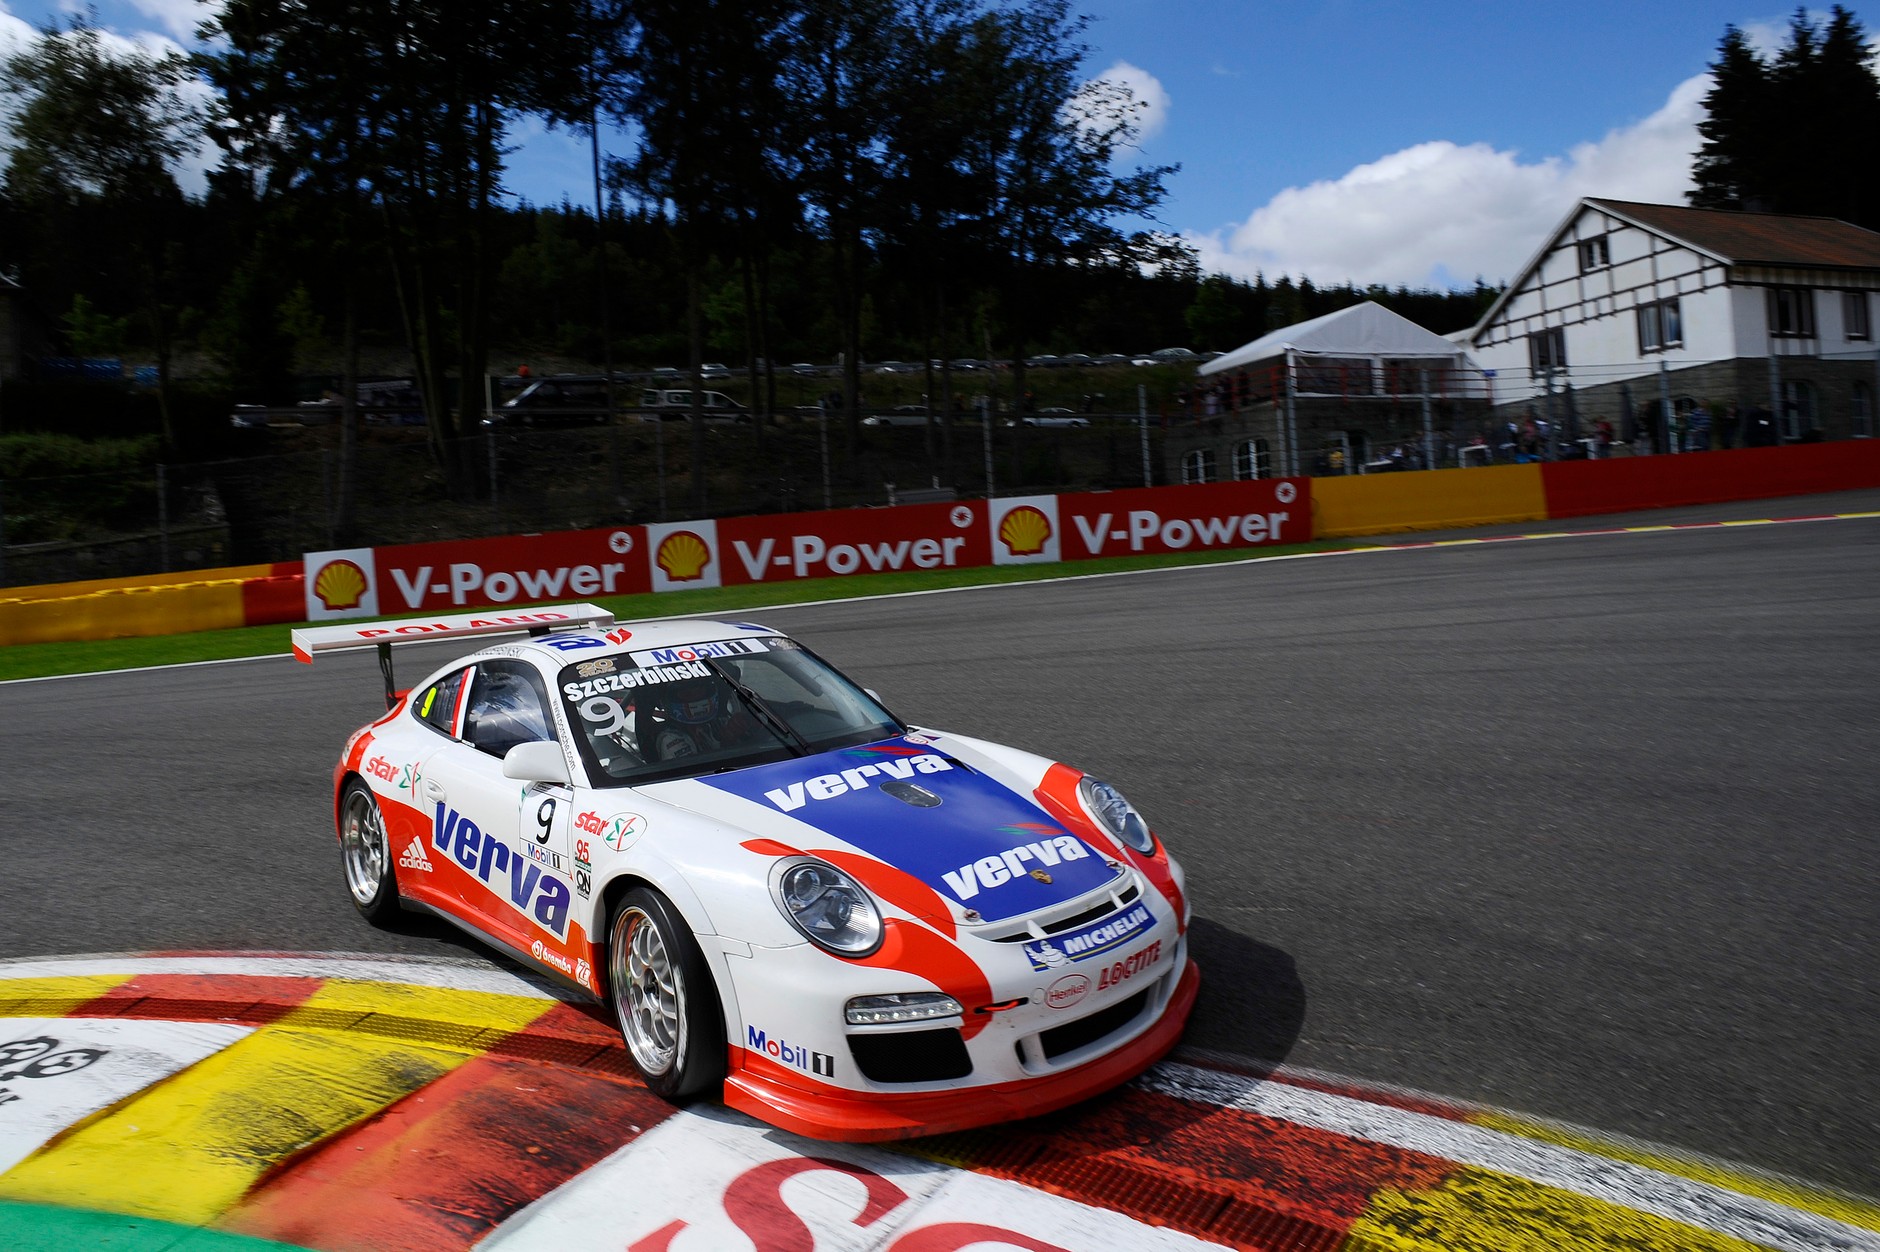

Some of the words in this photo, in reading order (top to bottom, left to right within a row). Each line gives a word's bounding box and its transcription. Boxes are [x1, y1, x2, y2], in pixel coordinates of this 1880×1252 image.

[1072, 510, 1289, 554] V-Power
[733, 535, 965, 580] V-Power
[391, 562, 625, 608] V-Power
[357, 613, 569, 638] POLAND
[651, 643, 727, 663] Mobil
[726, 641, 750, 654] 1
[563, 660, 712, 702] Szczerbinski
[580, 696, 626, 737] 9
[366, 756, 400, 782] star
[764, 753, 953, 813] verva
[536, 797, 557, 844] 9
[574, 811, 609, 836] star
[399, 856, 433, 873] adidas
[435, 801, 570, 937] verva
[527, 842, 552, 866] Mobil
[552, 852, 561, 869] 1
[576, 839, 590, 864] 95
[941, 835, 1092, 901] verva
[1063, 906, 1149, 954] MICHELIN
[542, 947, 572, 975] brembo
[1097, 939, 1162, 991] LOCTITE
[1048, 980, 1088, 1002] Henkel
[748, 1024, 807, 1070] Mobil
[815, 1053, 831, 1077] 1
